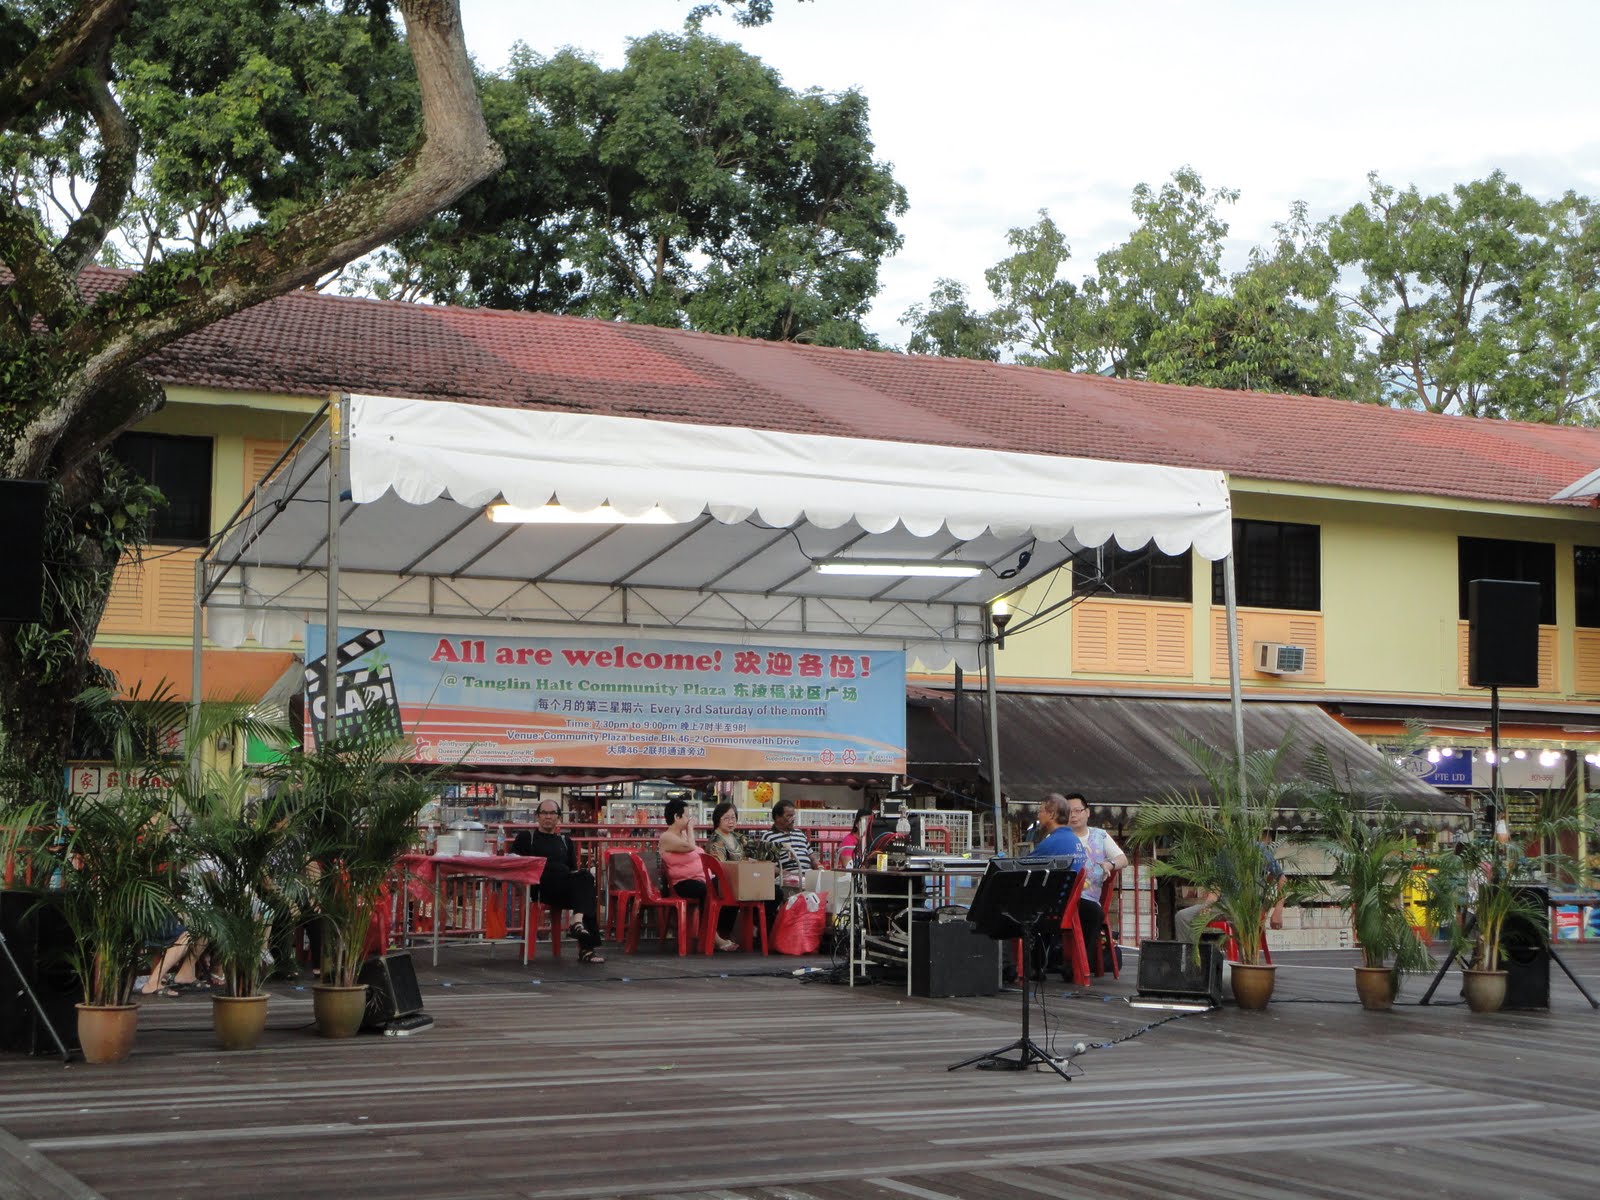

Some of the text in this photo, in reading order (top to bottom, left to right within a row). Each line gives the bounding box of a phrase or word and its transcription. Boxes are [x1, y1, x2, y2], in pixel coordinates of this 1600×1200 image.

[431, 638, 722, 671] All are welcome!
[444, 675, 726, 696] @ Tanglin Halt Community Plaza
[733, 683, 858, 702] 东陵福社区广场
[538, 698, 643, 714] 每个月的第三星期六
[650, 704, 826, 717] Every 3rd Saturday of the month
[566, 719, 593, 728] Time:
[595, 720, 629, 730] 7:30pm
[644, 721, 677, 731] 9:00pm
[680, 722, 746, 732] 晚上7时半至9时
[506, 730, 541, 740] Venue:
[544, 731, 599, 742] Community
[601, 732, 625, 742] Plaza
[629, 733, 659, 742] beside
[661, 734, 676, 743] Blk
[702, 736, 774, 745] Commonwealth
[776, 737, 800, 745] Drive
[607, 746, 705, 756] 大牌46-2联邦通道旁边
